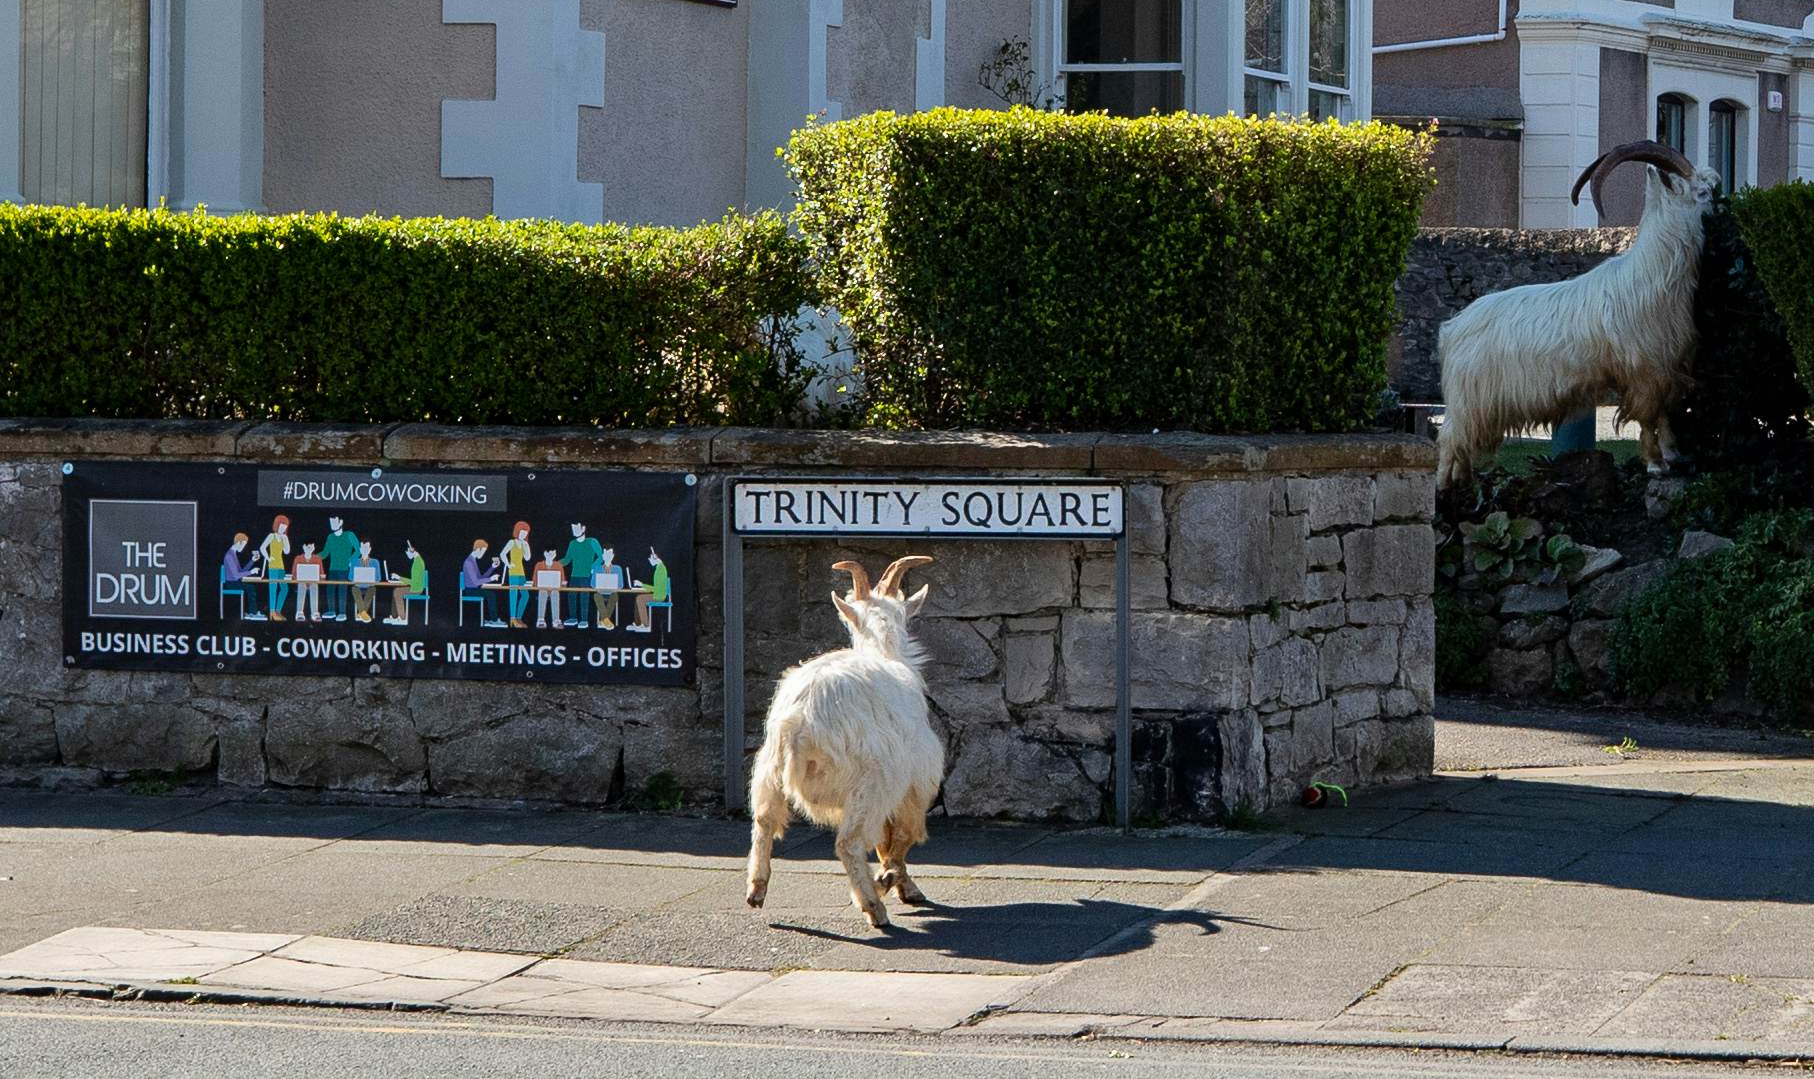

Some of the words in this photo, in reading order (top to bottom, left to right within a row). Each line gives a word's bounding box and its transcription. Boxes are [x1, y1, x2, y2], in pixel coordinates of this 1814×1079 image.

[283, 481, 488, 504] #DRUMCOWORKING
[745, 490, 920, 526] TRINITY
[941, 491, 1112, 528] SQUARE
[121, 541, 167, 568] THE
[96, 572, 190, 606] DRUM
[81, 631, 190, 655] BUSINESS
[196, 635, 257, 657] CLUB
[276, 637, 426, 662] COWORKING
[446, 642, 567, 666] MEETINGS
[586, 646, 683, 669] OFFICES
